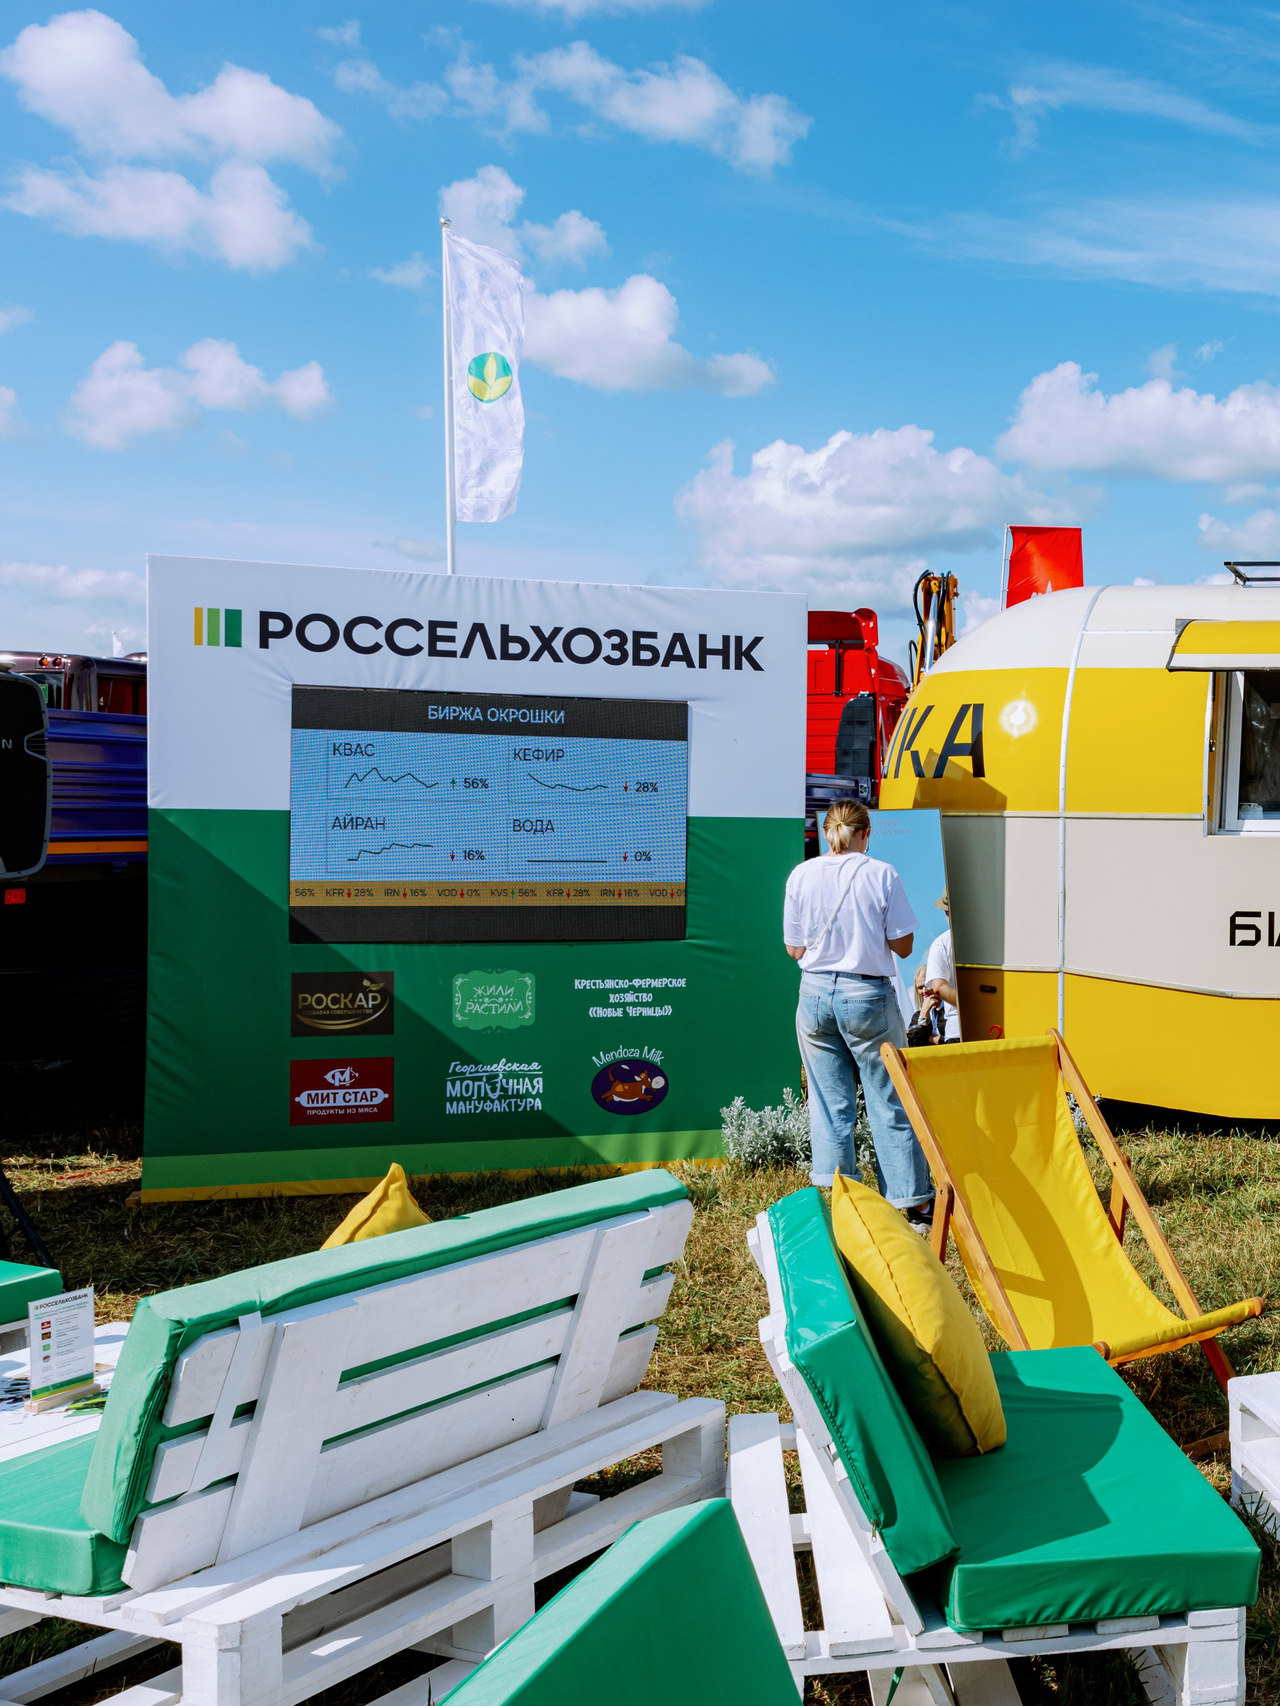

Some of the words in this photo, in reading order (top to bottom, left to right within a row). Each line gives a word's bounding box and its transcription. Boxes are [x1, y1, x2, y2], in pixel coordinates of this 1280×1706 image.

[258, 610, 766, 672] РОССЕЛЬХОЗБАНК
[428, 705, 483, 722] БИРЖА
[487, 707, 566, 724] ОКРОШКИ
[332, 742, 376, 757] КВАС
[513, 748, 566, 762] КЕФИР
[463, 778, 489, 789] 56%
[635, 782, 659, 793] 28%
[331, 813, 386, 831] АЙРАН
[512, 819, 555, 835] ВОДА
[462, 850, 485, 861] 16%
[634, 851, 652, 862] 0%
[295, 888, 315, 897] 56%
[325, 888, 344, 897] KFR
[354, 888, 374, 897] 28%
[384, 888, 400, 897] IRN
[410, 888, 427, 897] 16%
[437, 888, 458, 897] VOD
[467, 888, 481, 897] 0%
[518, 888, 538, 897] 56%
[546, 888, 564, 897] KFR
[573, 888, 591, 897] 28%
[600, 888, 616, 897] IRN
[624, 888, 640, 897] 16%
[650, 888, 668, 897] VOD
[473, 985, 515, 998] ЖИЛИ
[574, 978, 687, 990] КРЕСТЬЯНСКО-ФЕРМЕРСКОЕ
[298, 992, 381, 1009] РОСКАР
[609, 990, 653, 1003] ХОЗЯЙСТВО
[464, 1000, 524, 1015] РАСТИЛИ
[591, 1044, 640, 1068] Mendoza
[642, 1046, 665, 1066] Milk
[448, 1058, 542, 1076] Георгиевская
[306, 1091, 340, 1105] МИТ
[342, 1090, 379, 1104] СТАР
[307, 1108, 345, 1116] ПРОДУКТЫ
[446, 1097, 543, 1115] МАНУФАКТУРА
